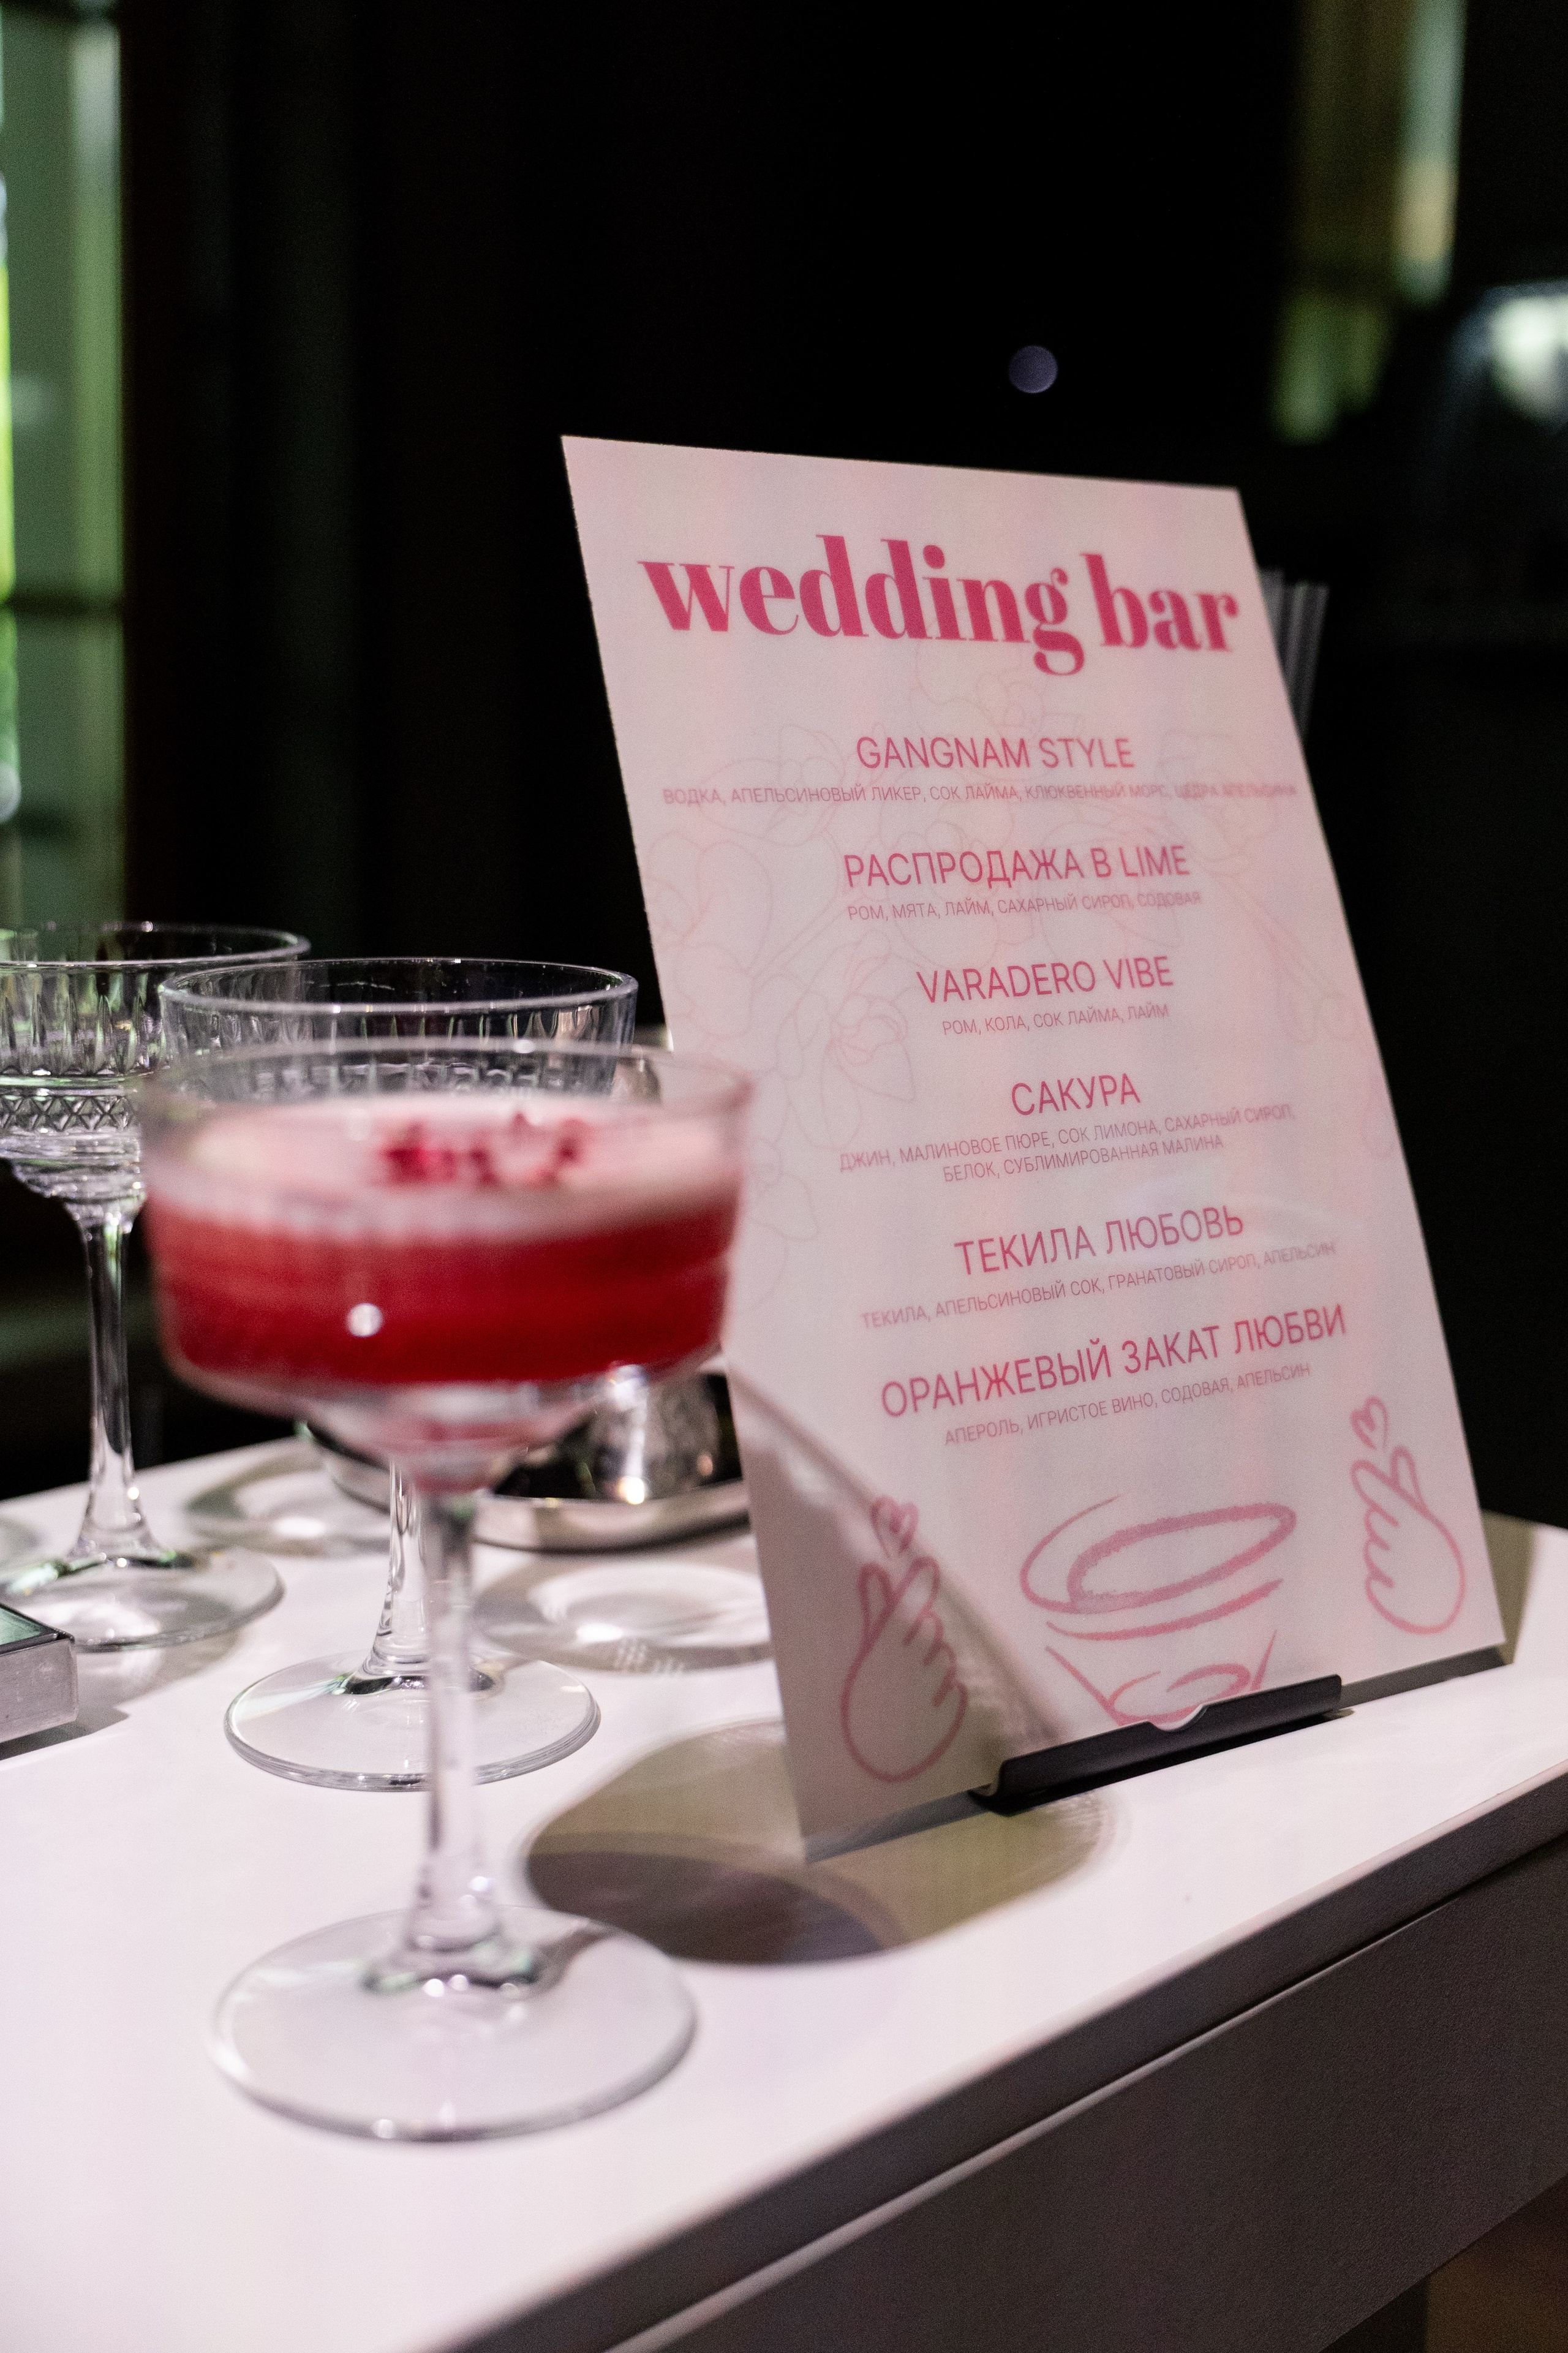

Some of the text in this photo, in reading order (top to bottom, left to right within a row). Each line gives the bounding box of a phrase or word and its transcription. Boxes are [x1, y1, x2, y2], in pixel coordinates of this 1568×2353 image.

[637, 535, 1238, 676] wedding bar
[858, 736, 1135, 769] GANGNAM STYLE
[663, 788, 726, 806] ВОДКА,
[731, 784, 865, 804] АПЕЛЬСИНОВЫЙ
[872, 786, 926, 804] ЛИКЕР,
[930, 787, 960, 800] СОК
[965, 782, 1022, 801] ЛАЙМА,
[1025, 783, 1126, 799] КЛЮКВЕННЫЙ
[845, 849, 1084, 888] РАСПРОДАЖА
[1119, 845, 1189, 877] LIME
[848, 892, 1200, 922] РОМ, МЯТА, ЛАЙМ, САХАРНЫЙ СИРОП, СОДОВАЯ
[916, 956, 1174, 1003] VARADERO VIBE
[943, 1003, 1169, 1035] РОМ, КОЛА, СОК ЛАЙМА, ЛАЙМ
[1012, 1073, 1140, 1116] САКУРА
[839, 1104, 1295, 1173] ДЖИН, МАЛИНОВОЕ ПЮРЕ, СОК ЛИМОНА, САХАРНЫЙ СИРОП,
[943, 1135, 1224, 1182] БЕЛОК, СУБЛИМИРОВАННАЯ МАЛИНА
[956, 1205, 1244, 1275] ТЕКИЛА ЛЮБОВЬ
[861, 1242, 1336, 1329] ТЕКИЛА, АПЕЛЬСИНОВЫЙ СОК, ГРАНАТОВЫЙ СИРОП, АПЕЛЬСИН
[881, 1304, 1346, 1418] ОРАНЖЕВЫЙ ЗАКАТ ЛЮБВИ
[945, 1362, 1311, 1446] АПЕРОЛЬ, ИГРИСТОЕ ВИНО, СОДОВАЯ, АПЕЛЬСИН
